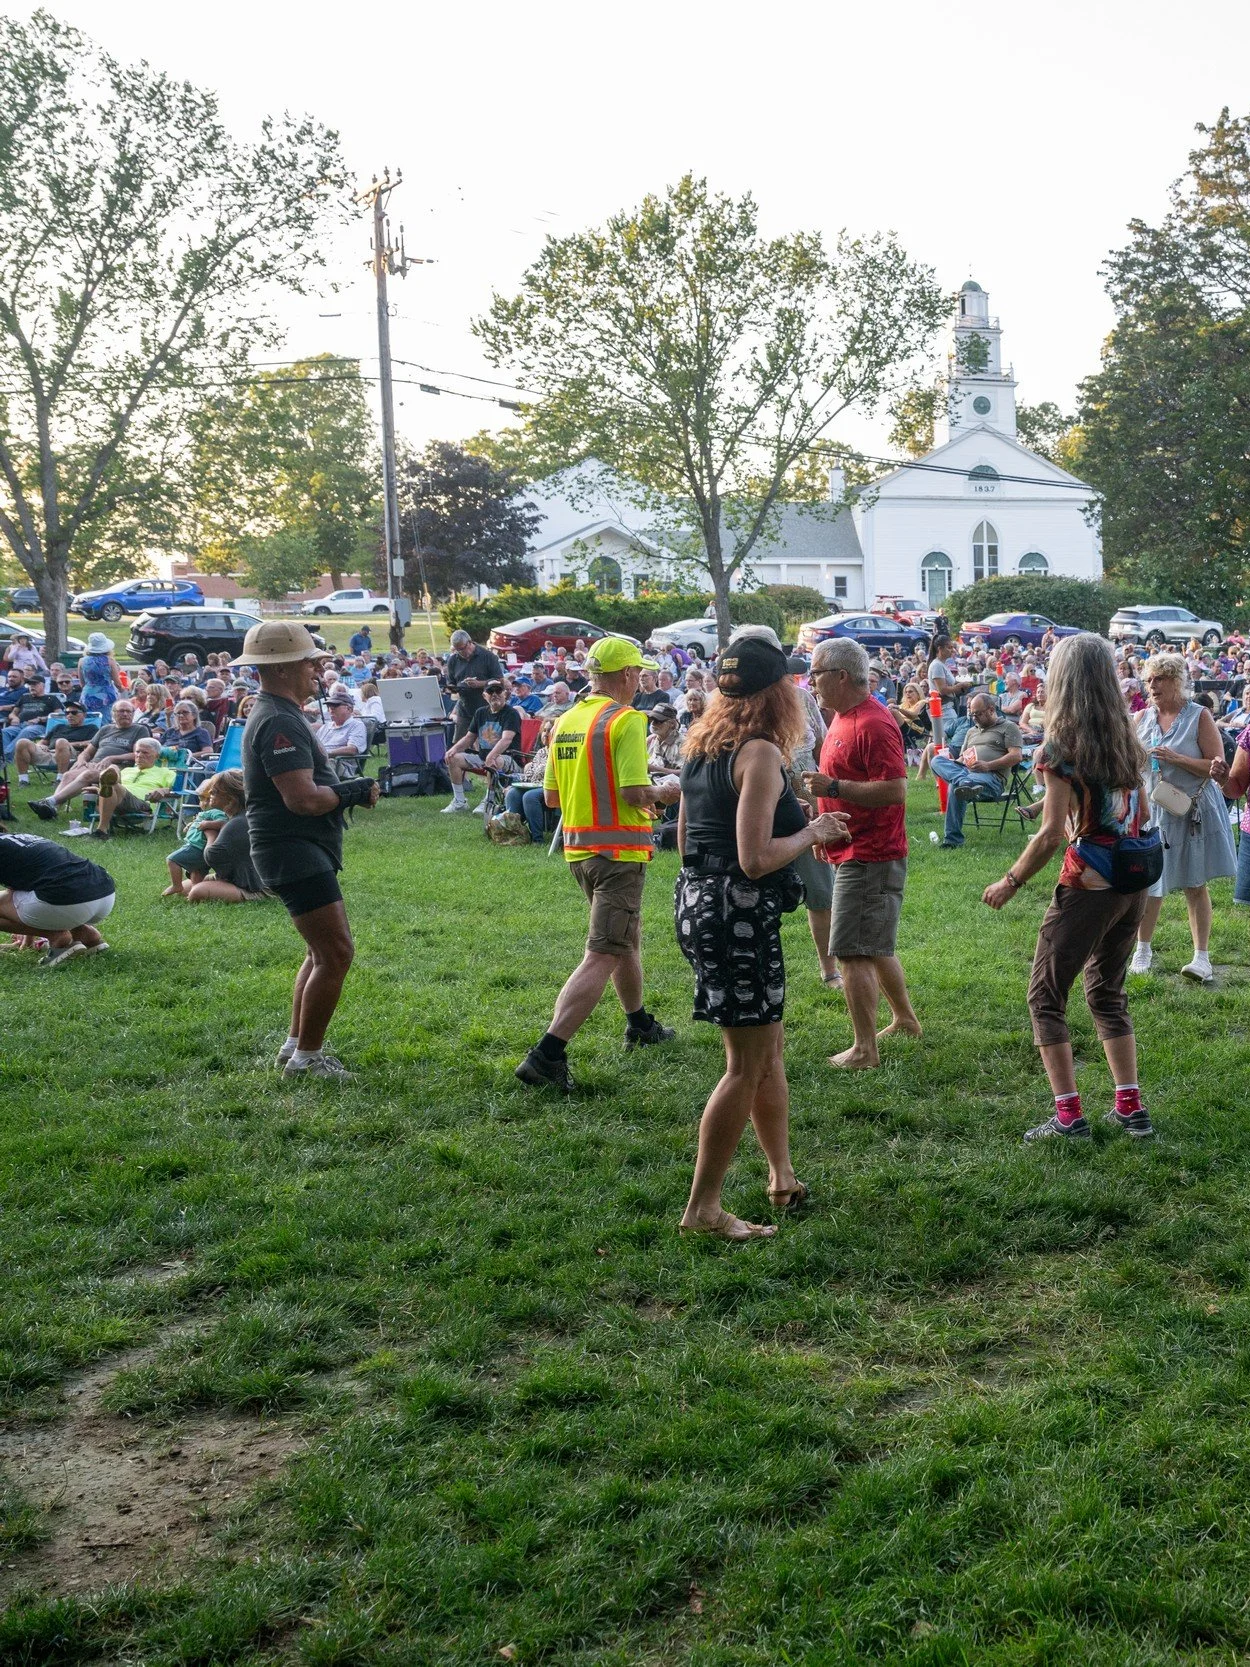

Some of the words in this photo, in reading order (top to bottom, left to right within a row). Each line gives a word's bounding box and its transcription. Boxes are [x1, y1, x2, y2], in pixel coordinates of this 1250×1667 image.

[974, 485, 995, 493] 1837
[555, 731, 586, 746] ndonderry
[273, 746, 297, 755] Reebok
[557, 746, 578, 760] ALERT
